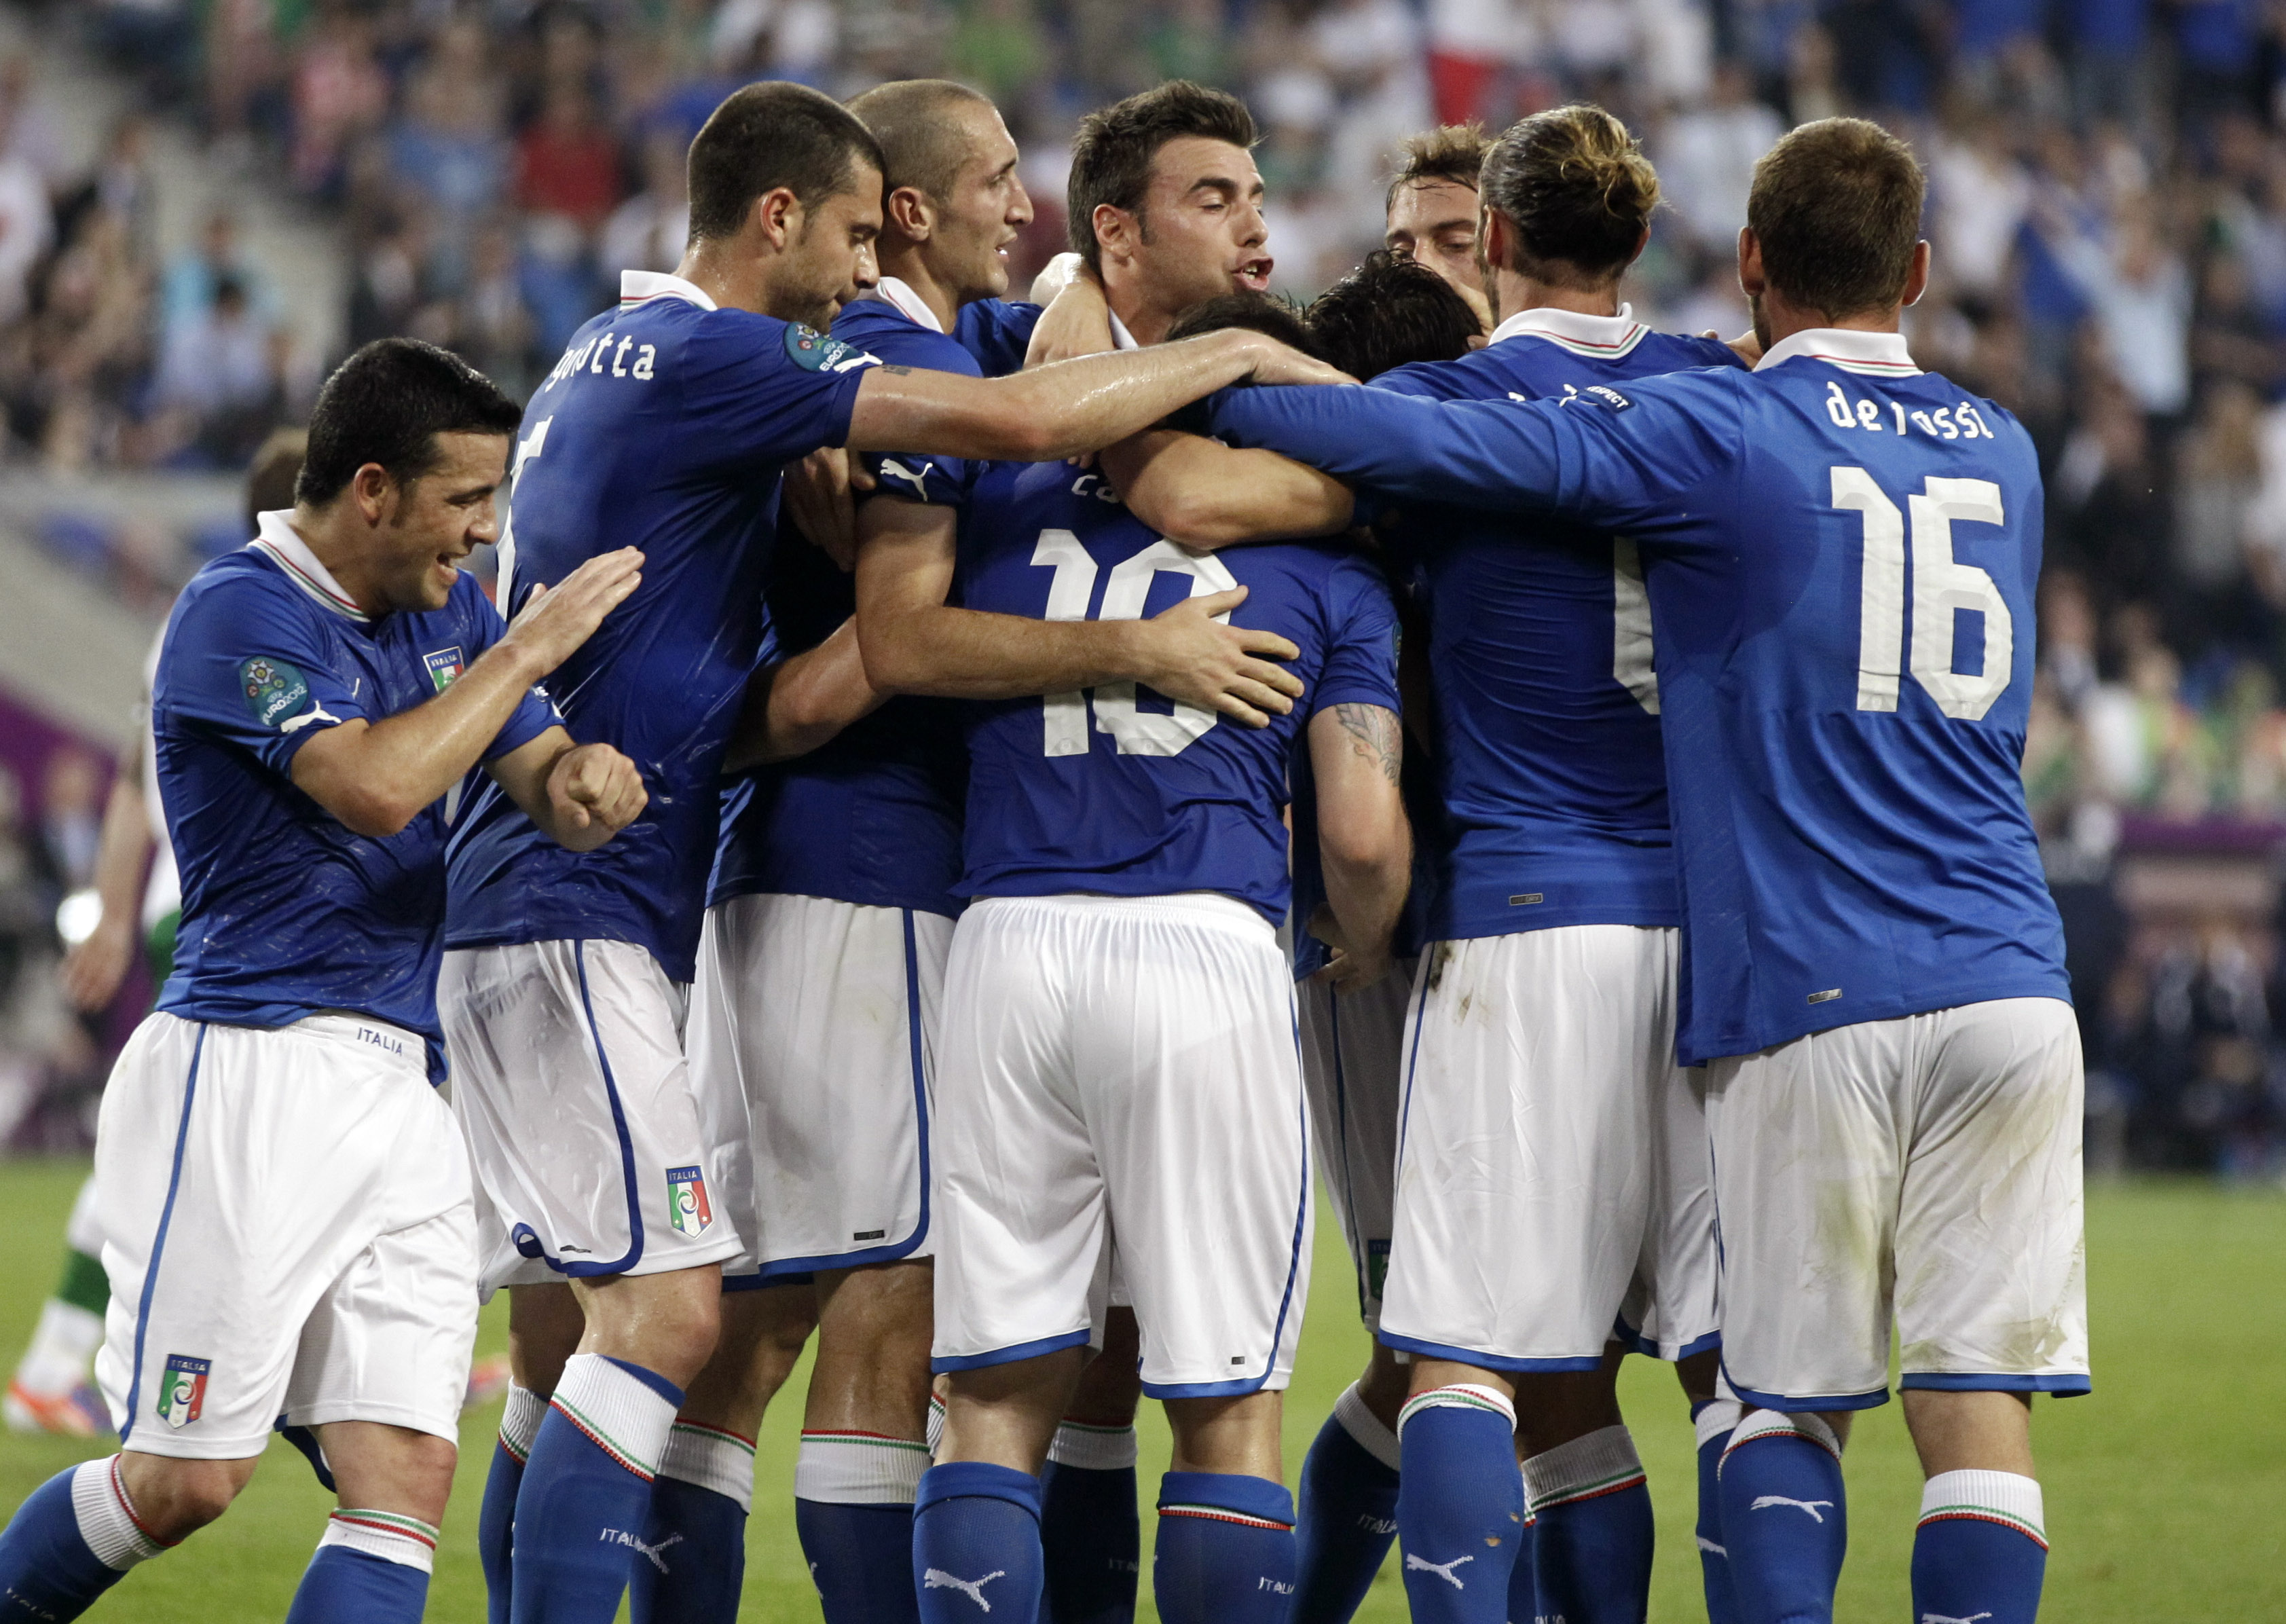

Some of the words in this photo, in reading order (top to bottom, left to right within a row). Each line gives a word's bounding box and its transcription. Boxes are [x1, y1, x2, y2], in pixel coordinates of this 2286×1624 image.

[1826, 381, 1883, 431] de
[1830, 466, 2012, 722] 16
[356, 1027, 403, 1056] ITALIA
[669, 1170, 697, 1181] ITALIA
[171, 1359, 206, 1371] ITALIA
